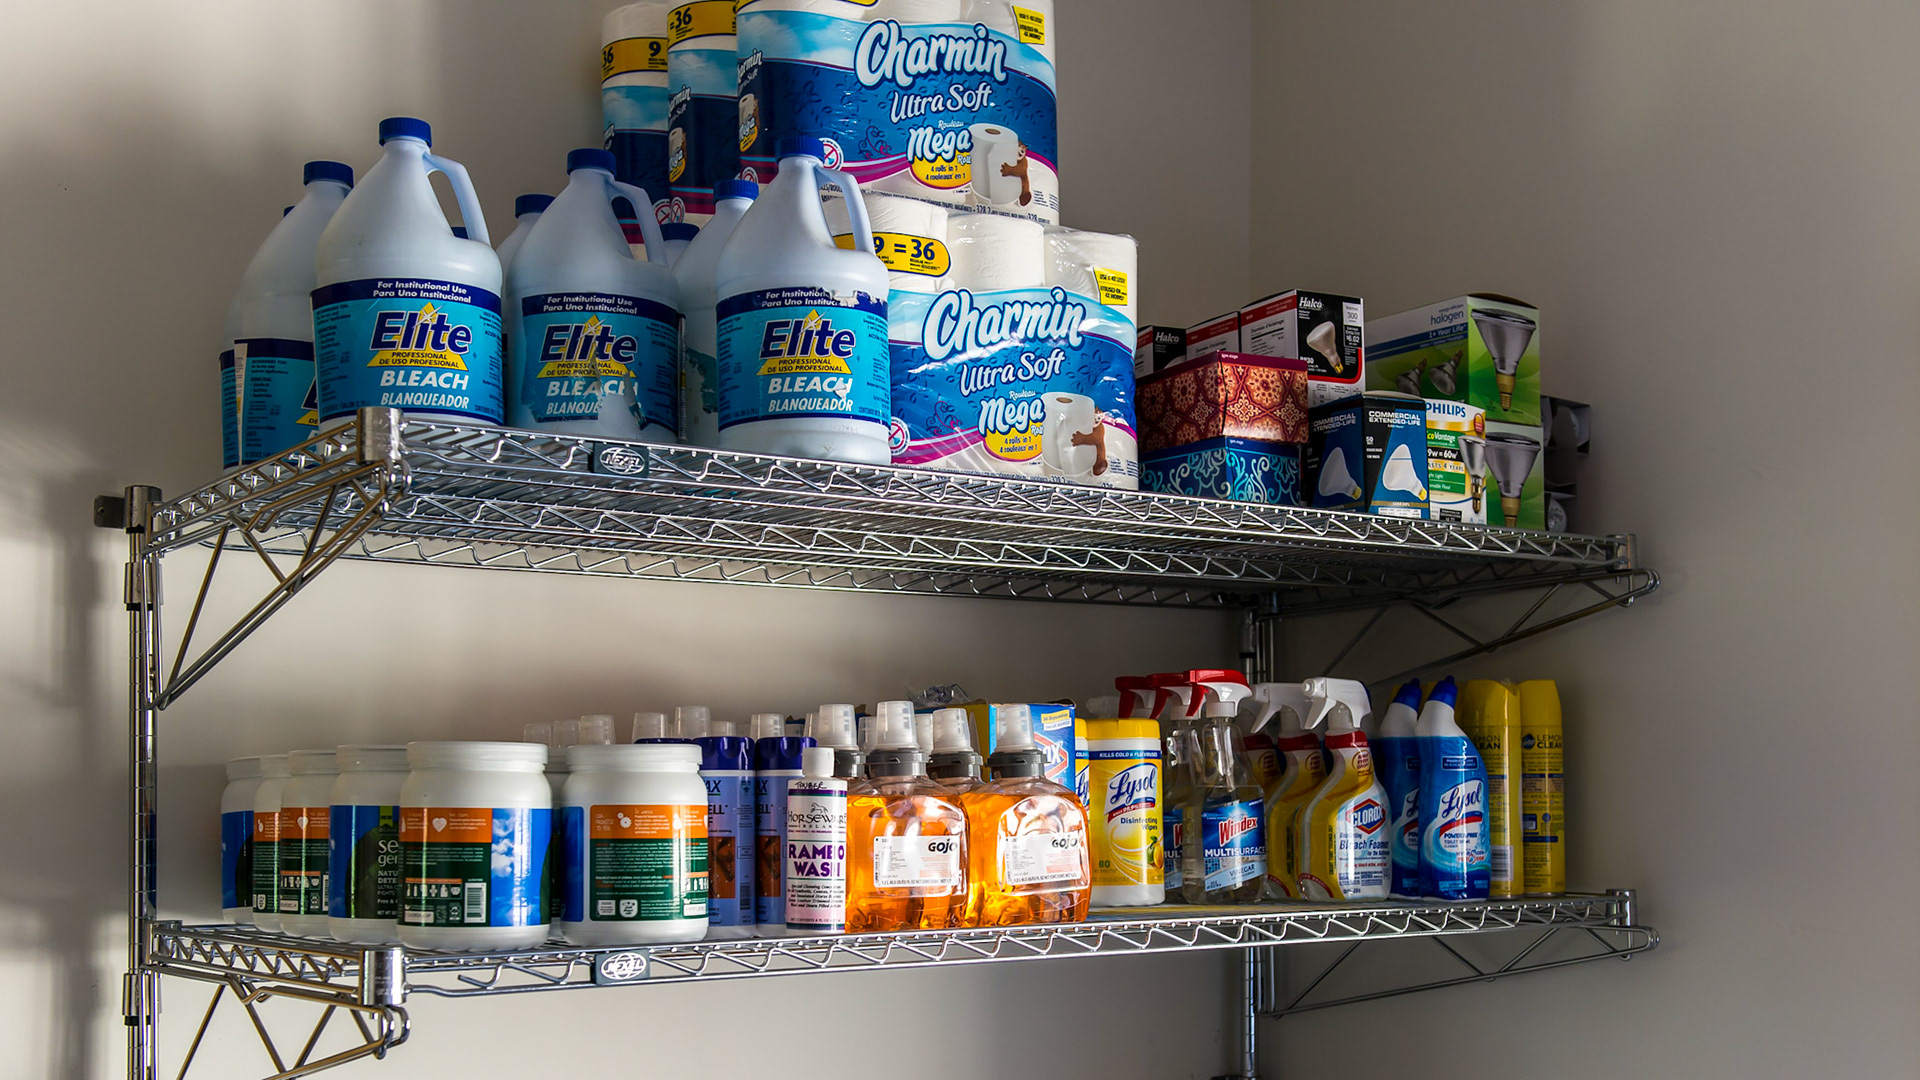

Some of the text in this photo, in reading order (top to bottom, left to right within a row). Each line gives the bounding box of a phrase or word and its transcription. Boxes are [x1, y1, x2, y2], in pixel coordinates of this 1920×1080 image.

[675, 7, 692, 29] 36
[648, 41, 661, 57] 9
[856, 20, 1006, 87] Charmin
[891, 92, 944, 122] Ultra
[907, 127, 972, 165] Mega
[911, 239, 935, 260] 36
[377, 281, 467, 294] For Institutional Use
[781, 290, 830, 298] Institution
[420, 290, 471, 303] Institucional
[563, 296, 615, 304] Institutional
[1299, 296, 1323, 309] Halco
[585, 304, 637, 314] Institucional
[923, 286, 1086, 361] Charmin
[1430, 311, 1464, 325] halogen
[370, 310, 472, 355] Elite
[759, 318, 856, 359] Elite
[1155, 331, 1180, 343] Halco
[540, 324, 637, 363] Elite
[392, 351, 447, 360] PROFESSIONAL
[409, 359, 459, 368] PROFESIONAL
[960, 348, 1065, 397] Ultra Soft
[380, 370, 469, 390] BLEACH
[768, 377, 853, 394] BLEACH
[380, 392, 470, 409] BLANQUEADOR
[768, 398, 854, 412] BLANQUEADOR
[978, 398, 1045, 436] Mega
[1368, 410, 1421, 420] COMMERCIAL
[1426, 403, 1466, 417] PHILIPS
[1368, 417, 1421, 426] EXTENDED-LIFE
[1427, 431, 1456, 443] coVantage
[708, 780, 721, 792] AX
[1110, 768, 1155, 805] Lysol
[1442, 782, 1482, 818] Lysol
[708, 804, 725, 814] ELL
[1353, 805, 1383, 826] CLOROX
[1219, 816, 1258, 847] Windex
[1205, 846, 1266, 857] MULTISURFACE
[1339, 840, 1367, 850] Blach
[1099, 860, 1110, 868] 80
